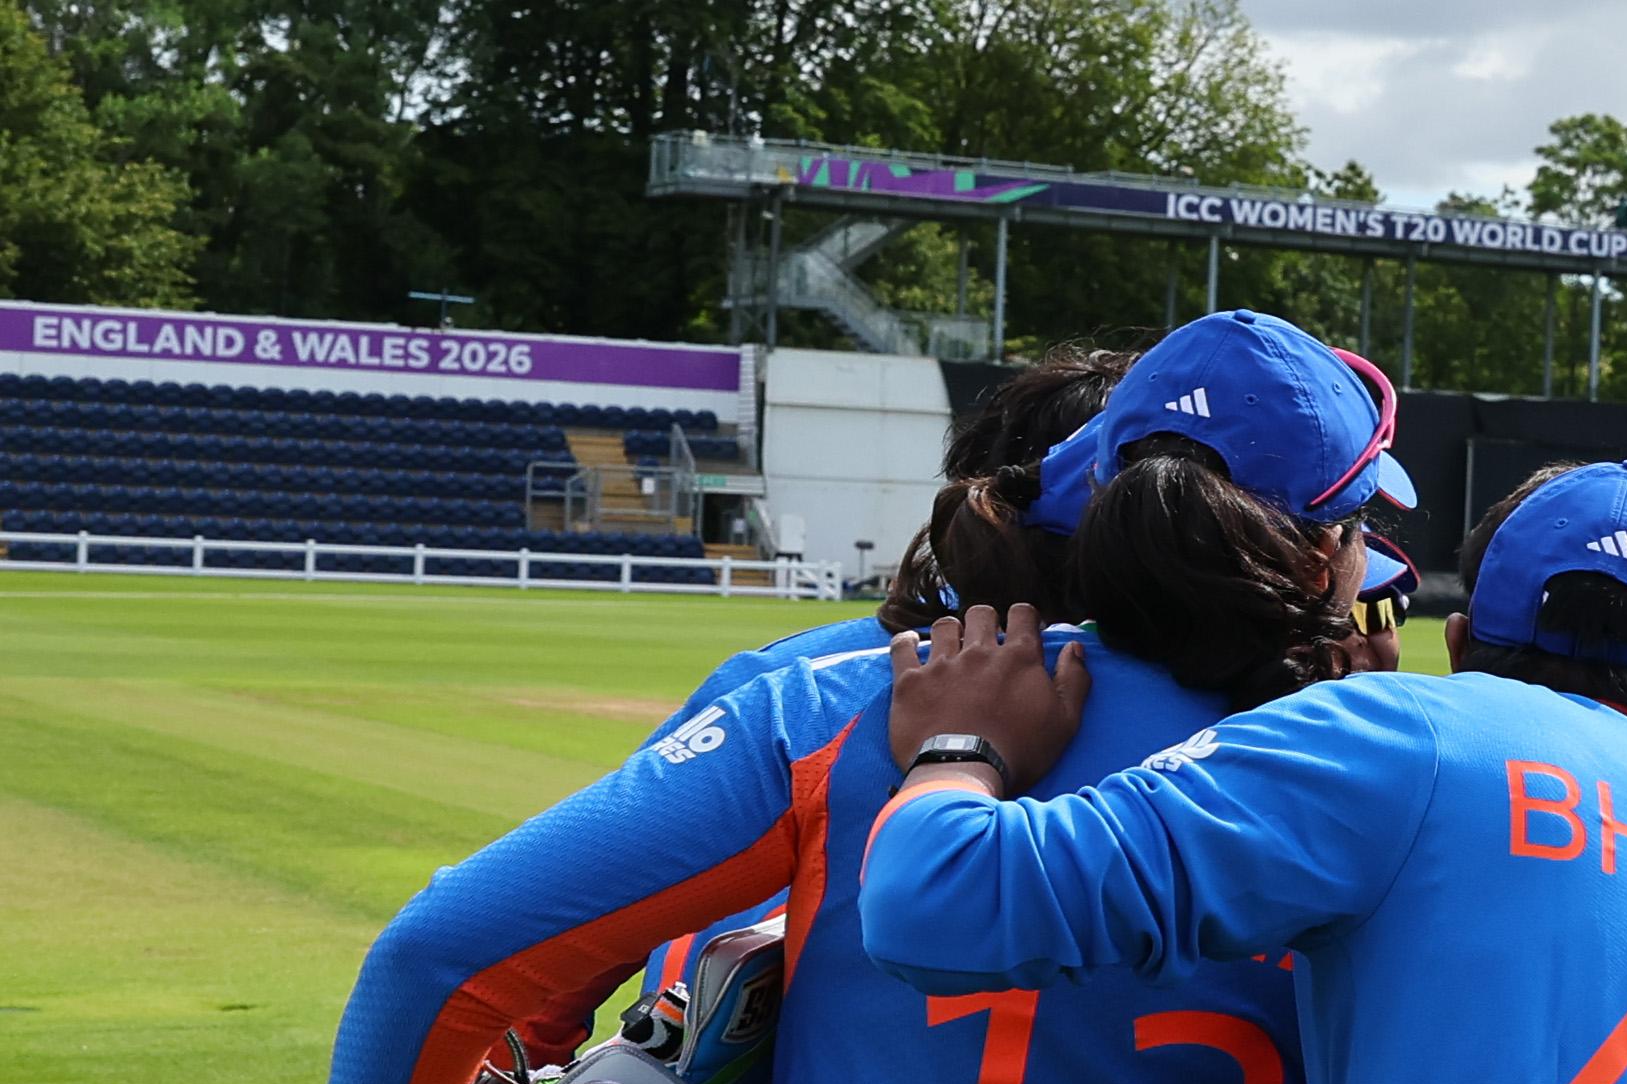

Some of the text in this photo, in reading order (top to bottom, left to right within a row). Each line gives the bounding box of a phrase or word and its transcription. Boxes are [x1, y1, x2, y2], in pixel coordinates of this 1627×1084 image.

[1166, 193, 1223, 223] ICC
[1230, 198, 1385, 238] WOMEN'S
[1391, 215, 1446, 243] T20
[1451, 219, 1563, 252] WORLD
[33, 315, 532, 375] ENGLAND & WALES 2026
